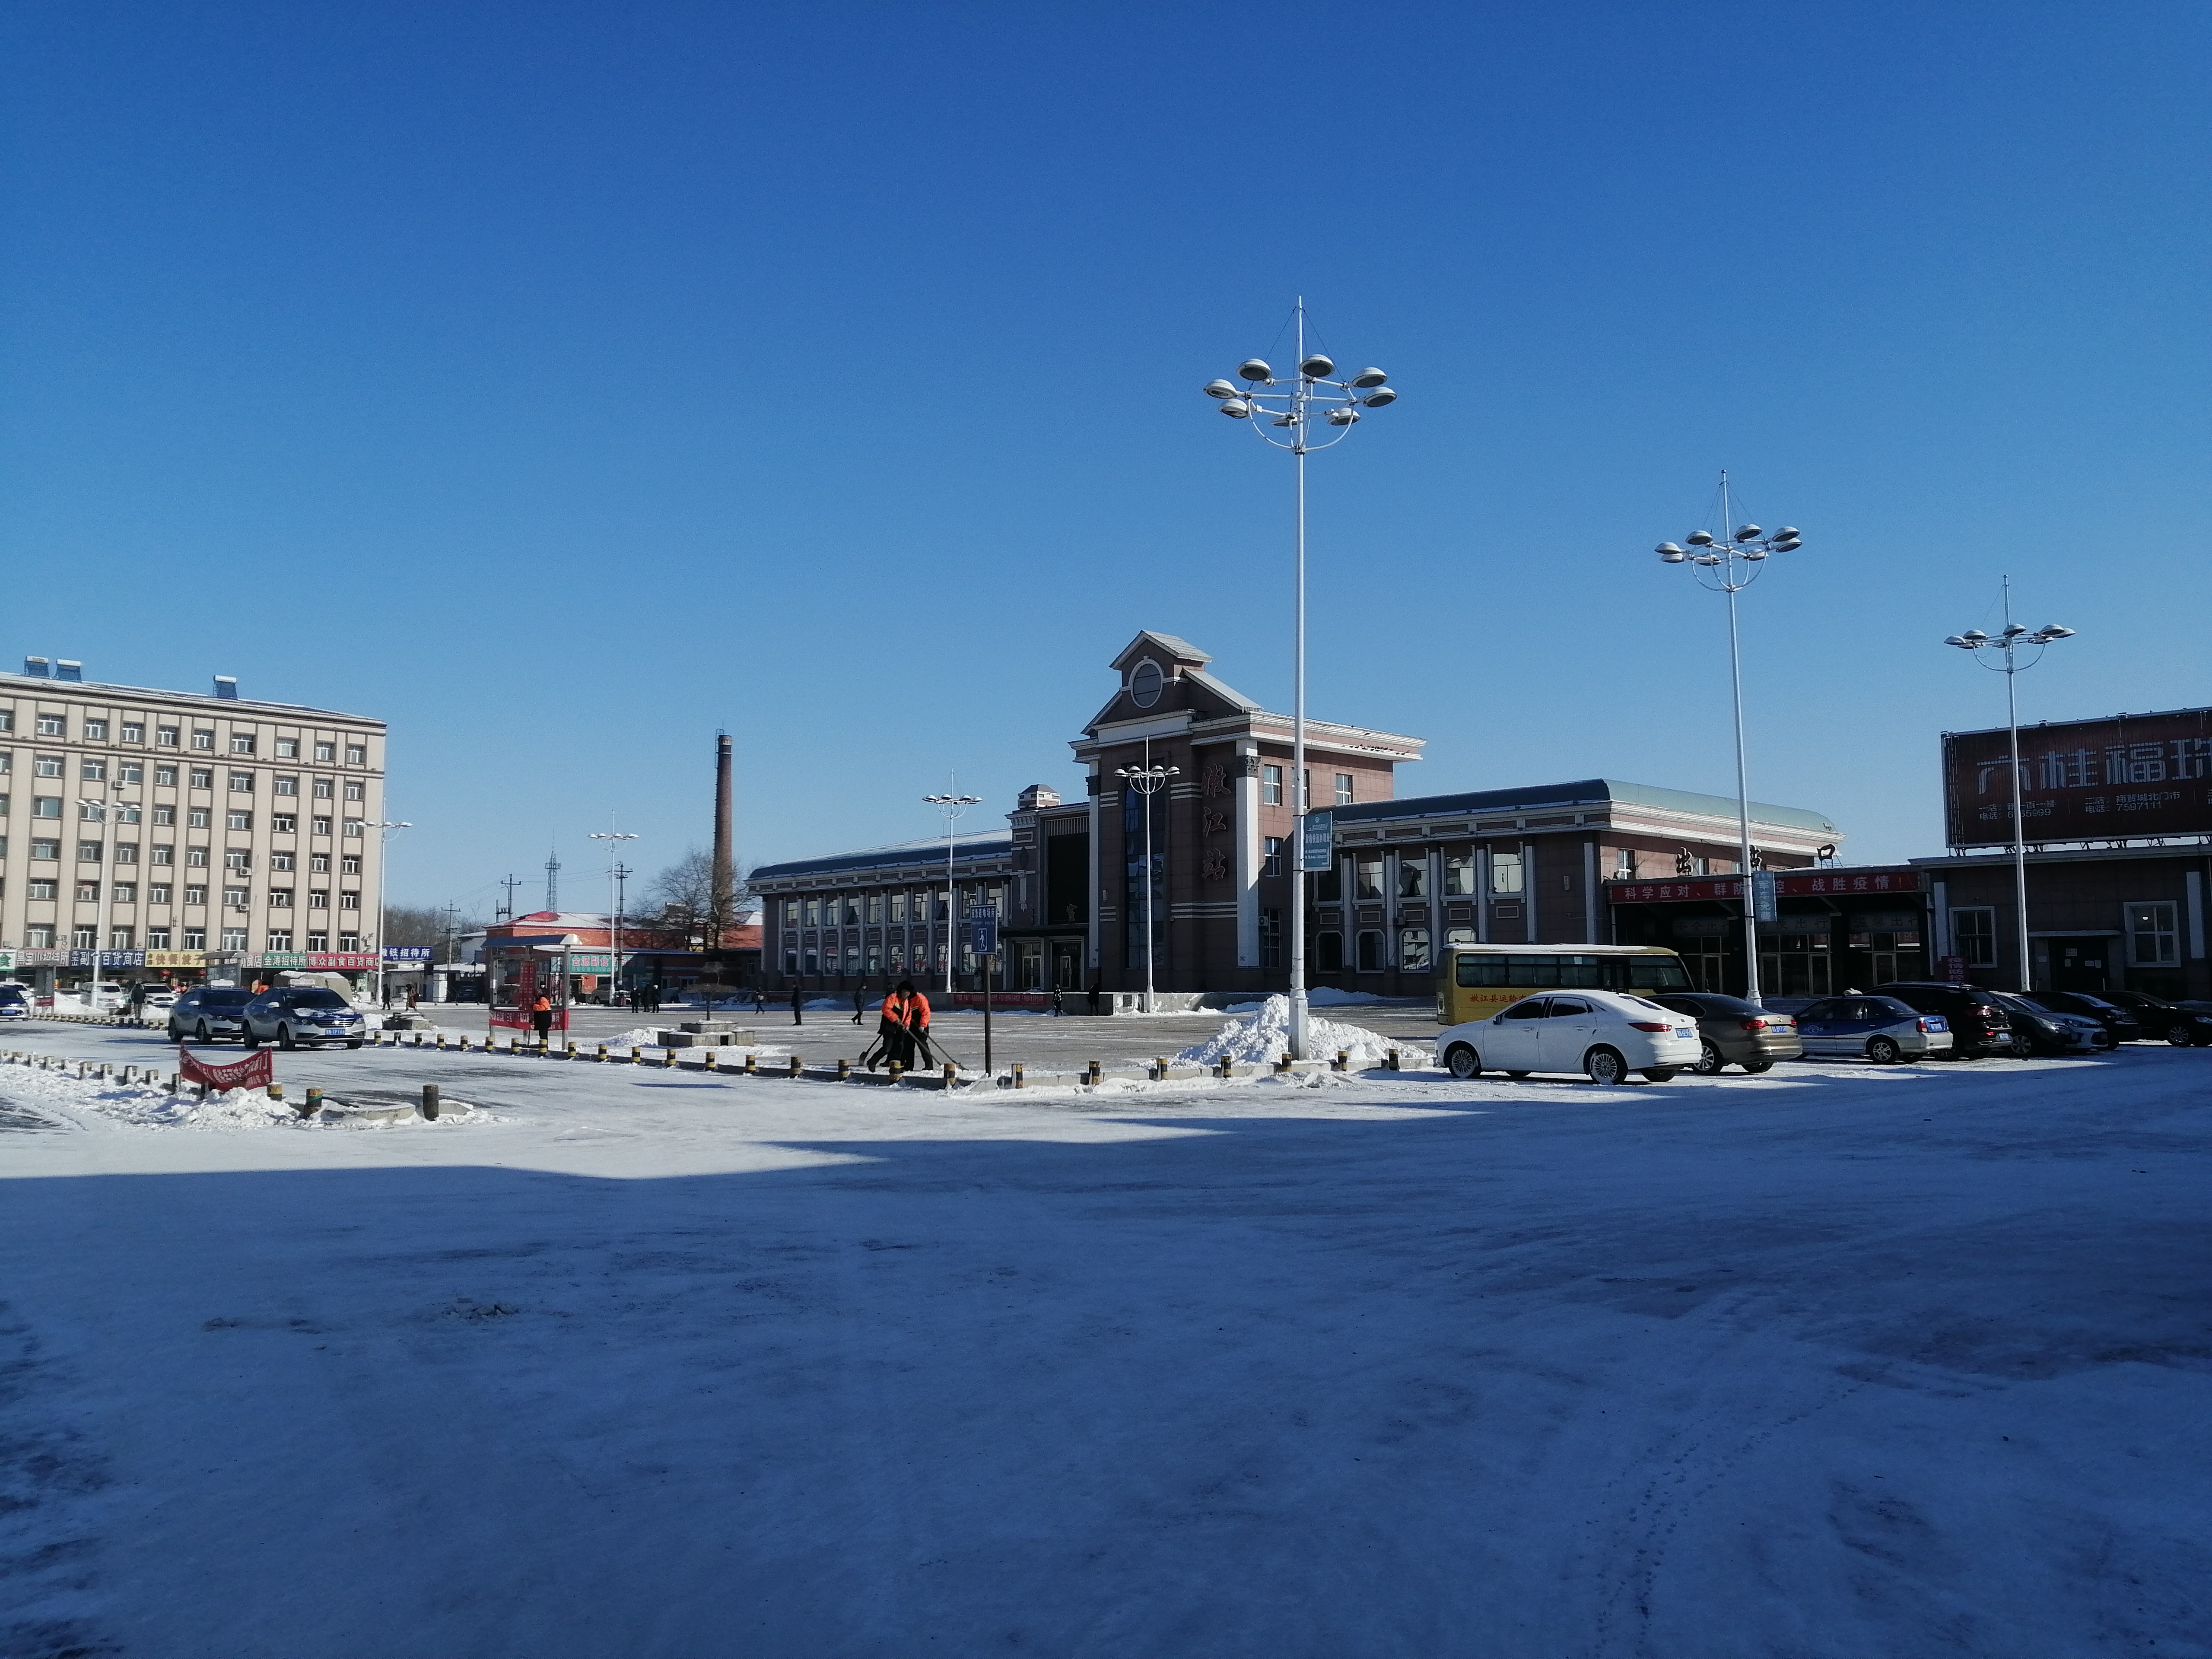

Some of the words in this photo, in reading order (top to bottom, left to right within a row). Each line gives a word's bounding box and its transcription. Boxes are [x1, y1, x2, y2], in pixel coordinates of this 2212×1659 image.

[2116, 801, 2162, 811] 7597111
[2007, 808, 2052, 819] 665999
[1624, 875, 1901, 900] 科学应对、群防控、战胜疫情!
[264, 955, 306, 966] 金涛招待所
